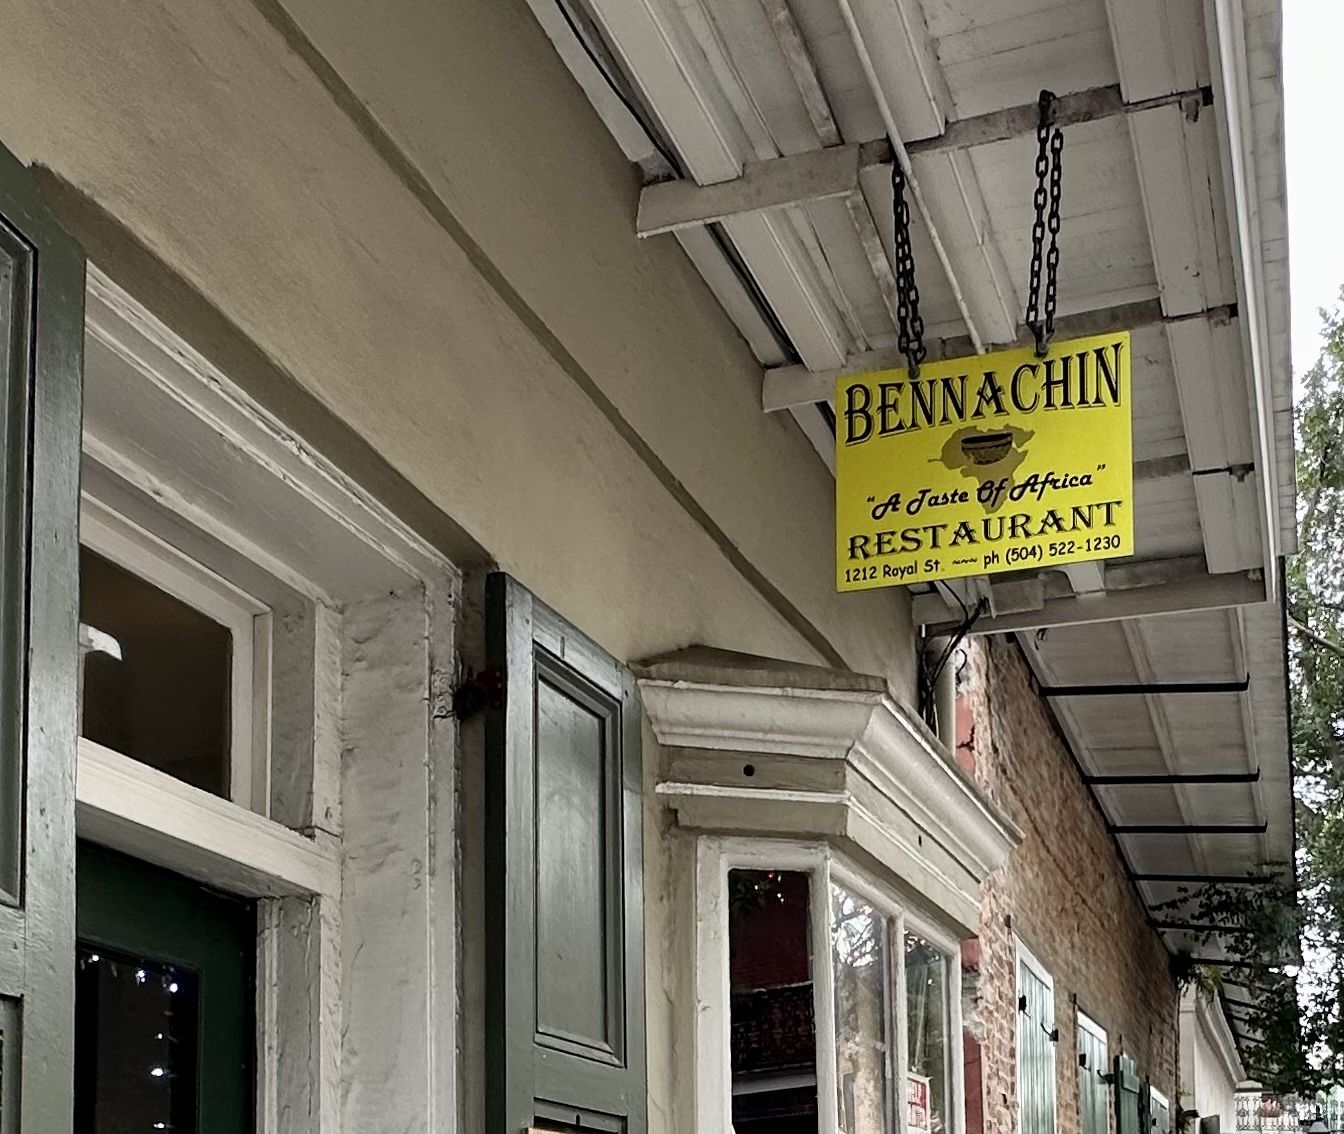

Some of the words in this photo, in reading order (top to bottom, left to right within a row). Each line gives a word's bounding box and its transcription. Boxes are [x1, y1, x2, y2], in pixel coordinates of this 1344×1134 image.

[843, 342, 1123, 447] BENNACHIN
[905, 488, 969, 515] Taste
[977, 477, 1008, 507] Of
[847, 501, 1123, 560] RESTAURANT
[845, 566, 877, 583] 1212
[882, 560, 918, 580] Royal
[983, 550, 1000, 569] ph
[1005, 545, 1043, 565] (504)
[1049, 534, 1121, 557] 522-1230
